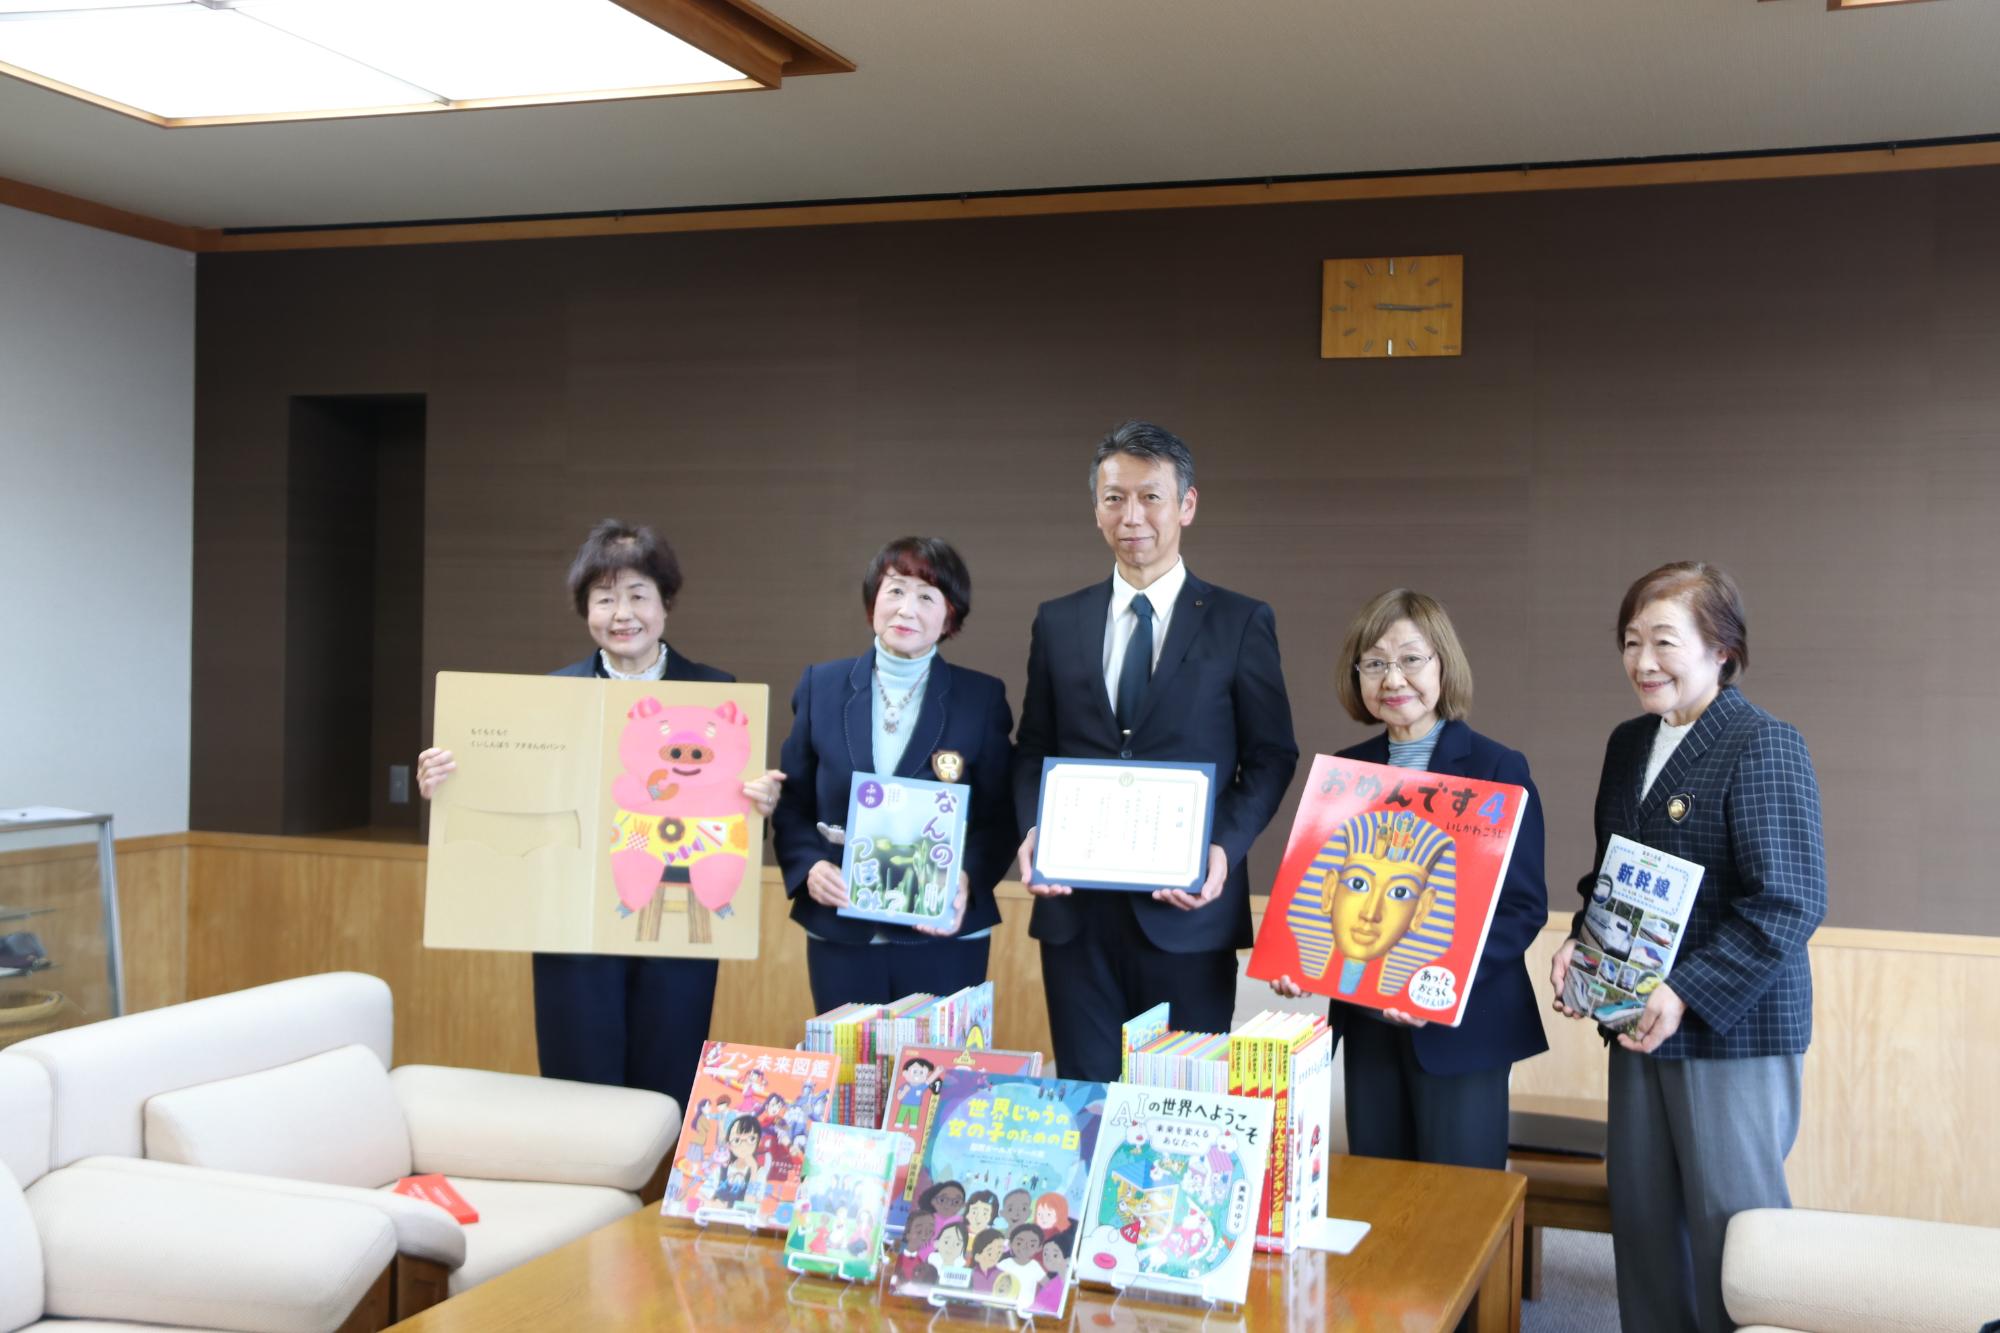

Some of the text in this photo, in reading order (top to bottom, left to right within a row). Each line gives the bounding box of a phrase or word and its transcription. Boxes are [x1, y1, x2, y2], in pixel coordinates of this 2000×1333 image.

[864, 784, 877, 806] ふゆ
[923, 790, 958, 867] なんの
[1616, 862, 1671, 902] 新幹線
[967, 1097, 1070, 1125] 世界じゅうの
[948, 1118, 1081, 1151] 女の子のための日
[1163, 1137, 1200, 1148] あなたへ
